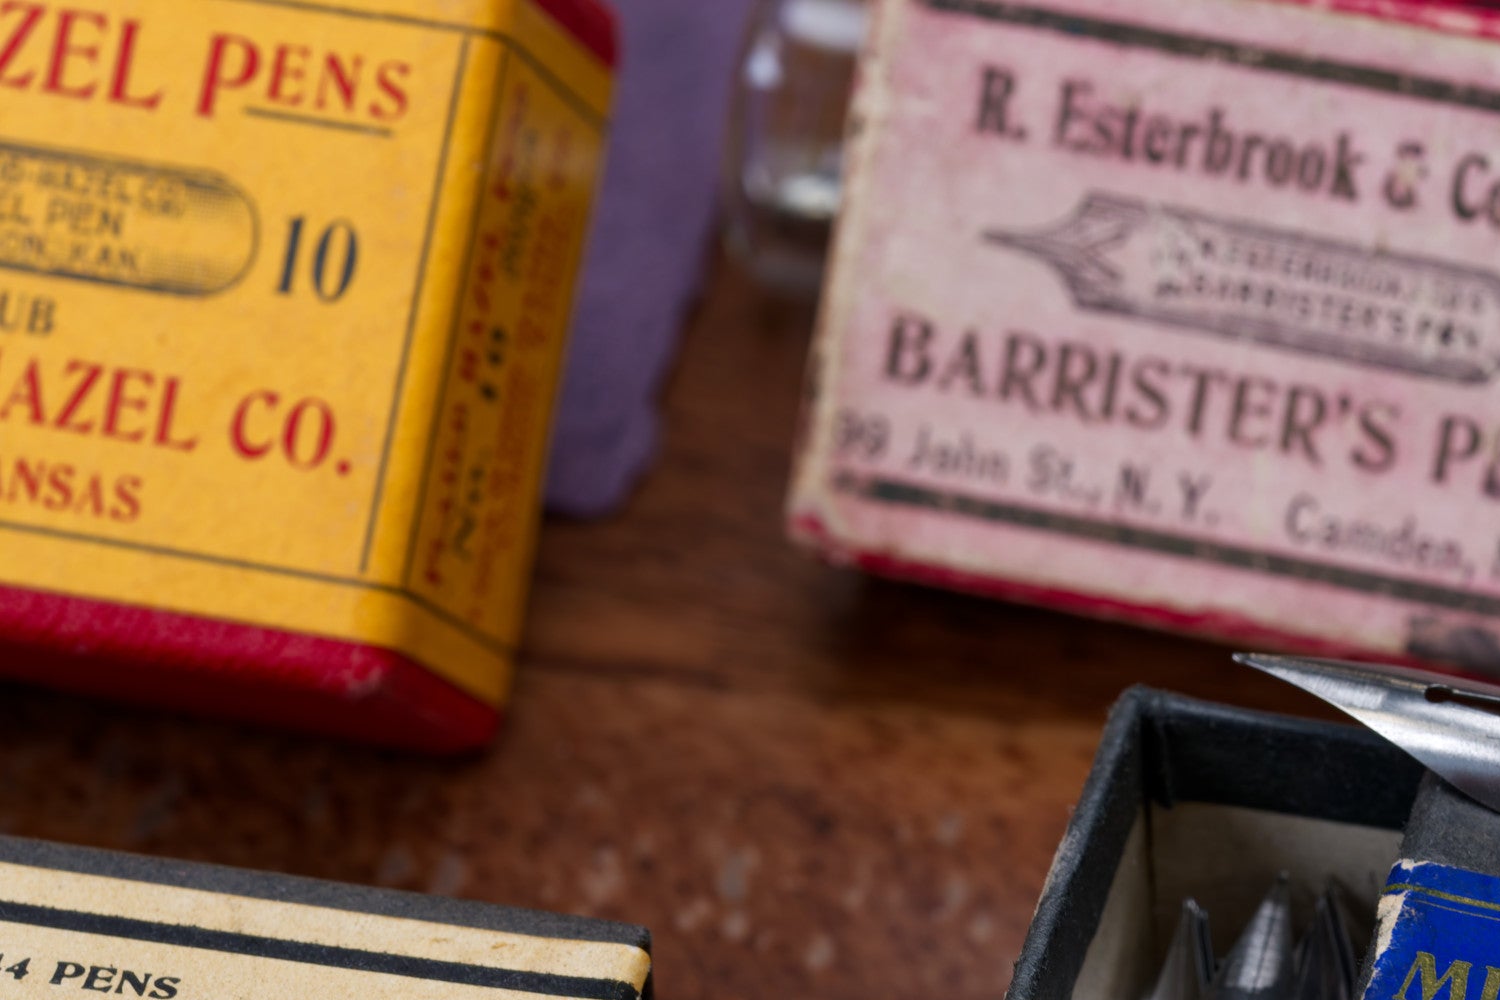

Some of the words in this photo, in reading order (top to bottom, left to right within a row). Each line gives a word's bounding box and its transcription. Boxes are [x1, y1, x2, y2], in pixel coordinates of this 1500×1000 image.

[195, 31, 412, 122] PENS
[973, 66, 1028, 142] R.
[1052, 76, 1364, 204] Esterbrook
[276, 216, 360, 303] 10
[0, 350, 200, 455] AZEL
[228, 388, 352, 478] CO.
[884, 306, 1400, 476] BARRISTER'S
[1282, 490, 1478, 588] Camden,
[49, 961, 182, 1000] PENS
